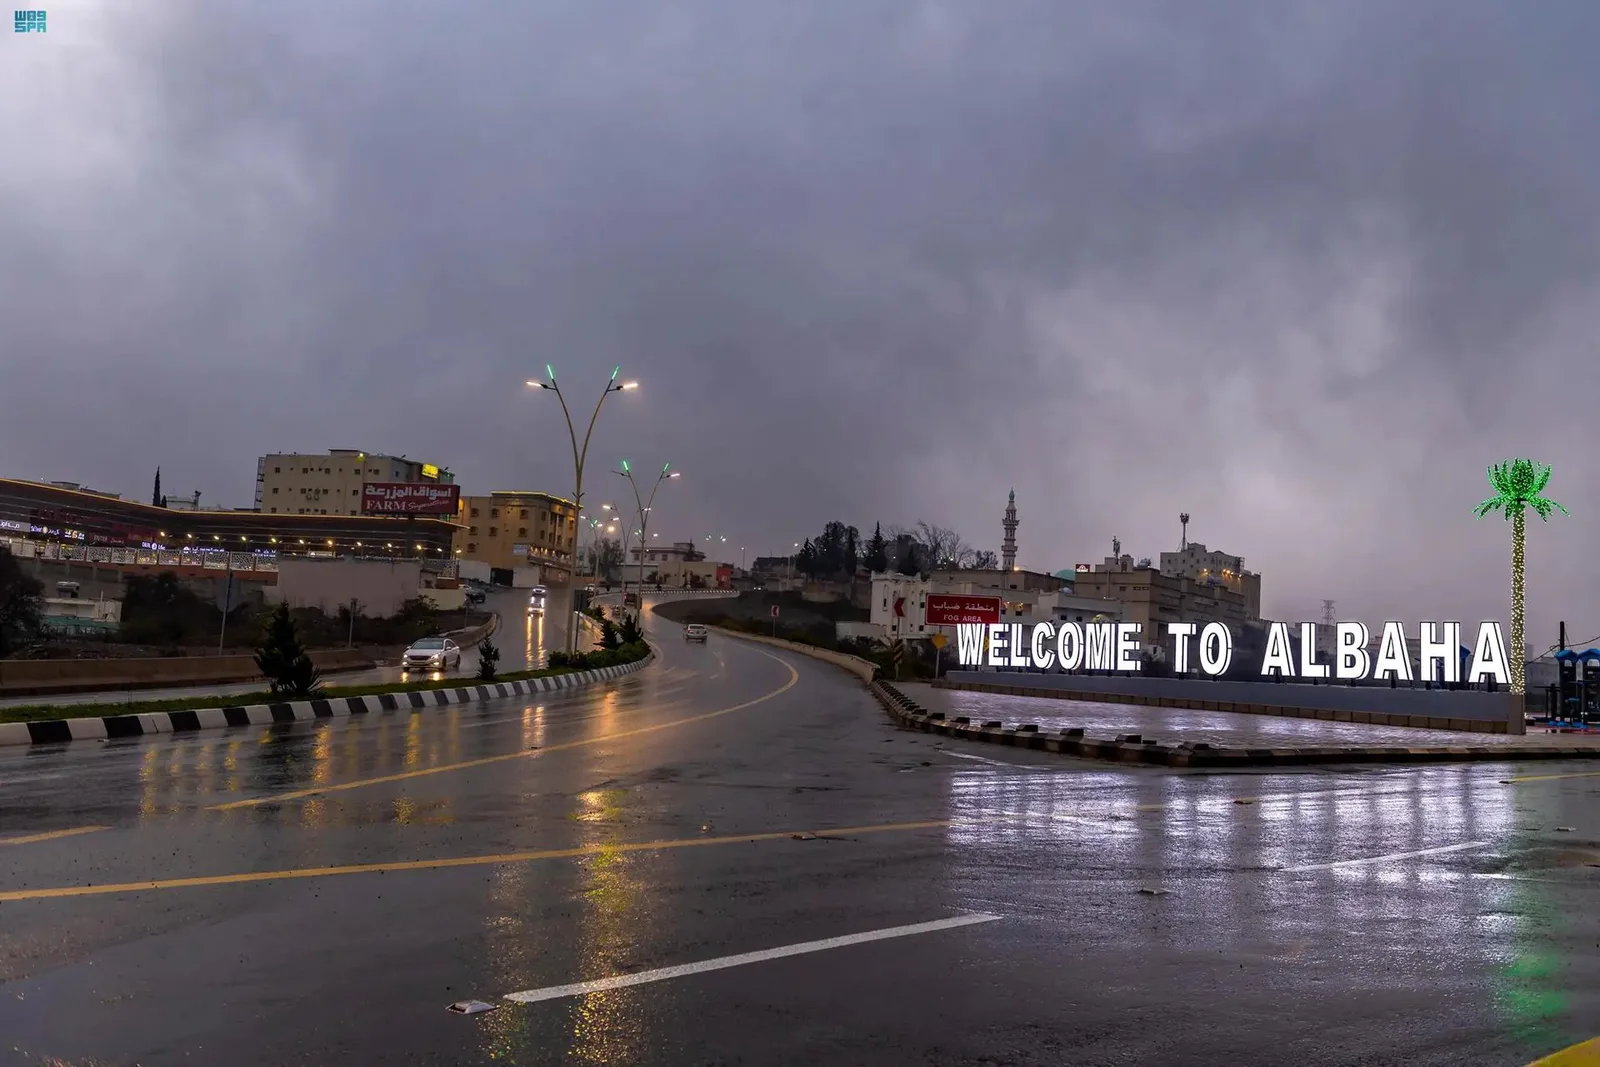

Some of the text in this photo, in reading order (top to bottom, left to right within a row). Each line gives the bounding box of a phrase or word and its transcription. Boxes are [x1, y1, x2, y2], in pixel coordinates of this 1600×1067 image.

[365, 485, 451, 500] اسواق المزرعة
[366, 500, 406, 510] FARM
[932, 602, 994, 612] منطقة ضباب
[956, 621, 1512, 684] WELCOME TO ALBAHA
